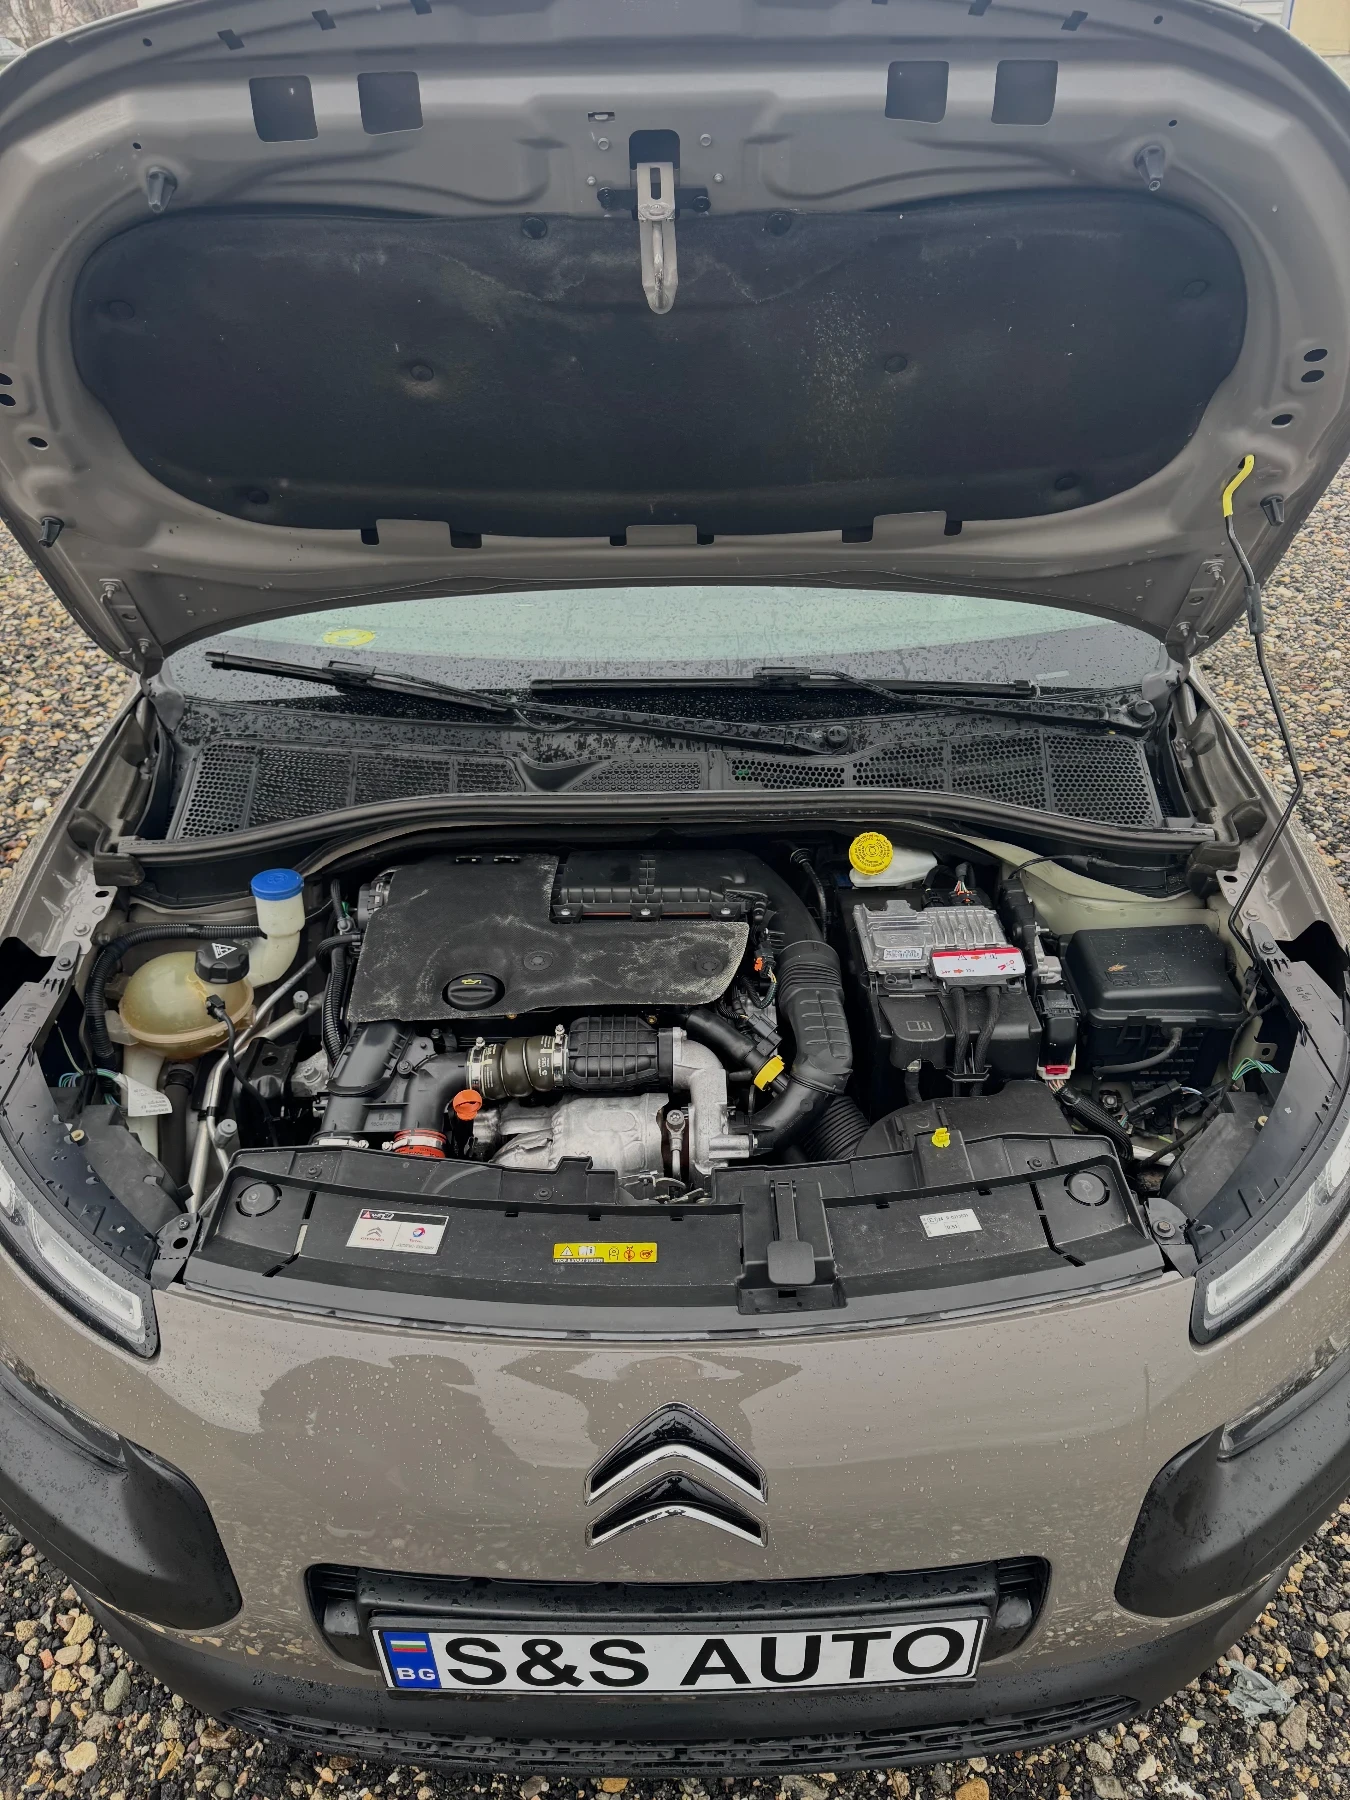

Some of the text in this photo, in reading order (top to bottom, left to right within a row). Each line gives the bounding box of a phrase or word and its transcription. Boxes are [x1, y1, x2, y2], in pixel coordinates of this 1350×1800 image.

[397, 1667, 437, 1682] BG
[445, 1626, 966, 1688] S&S AUTO
